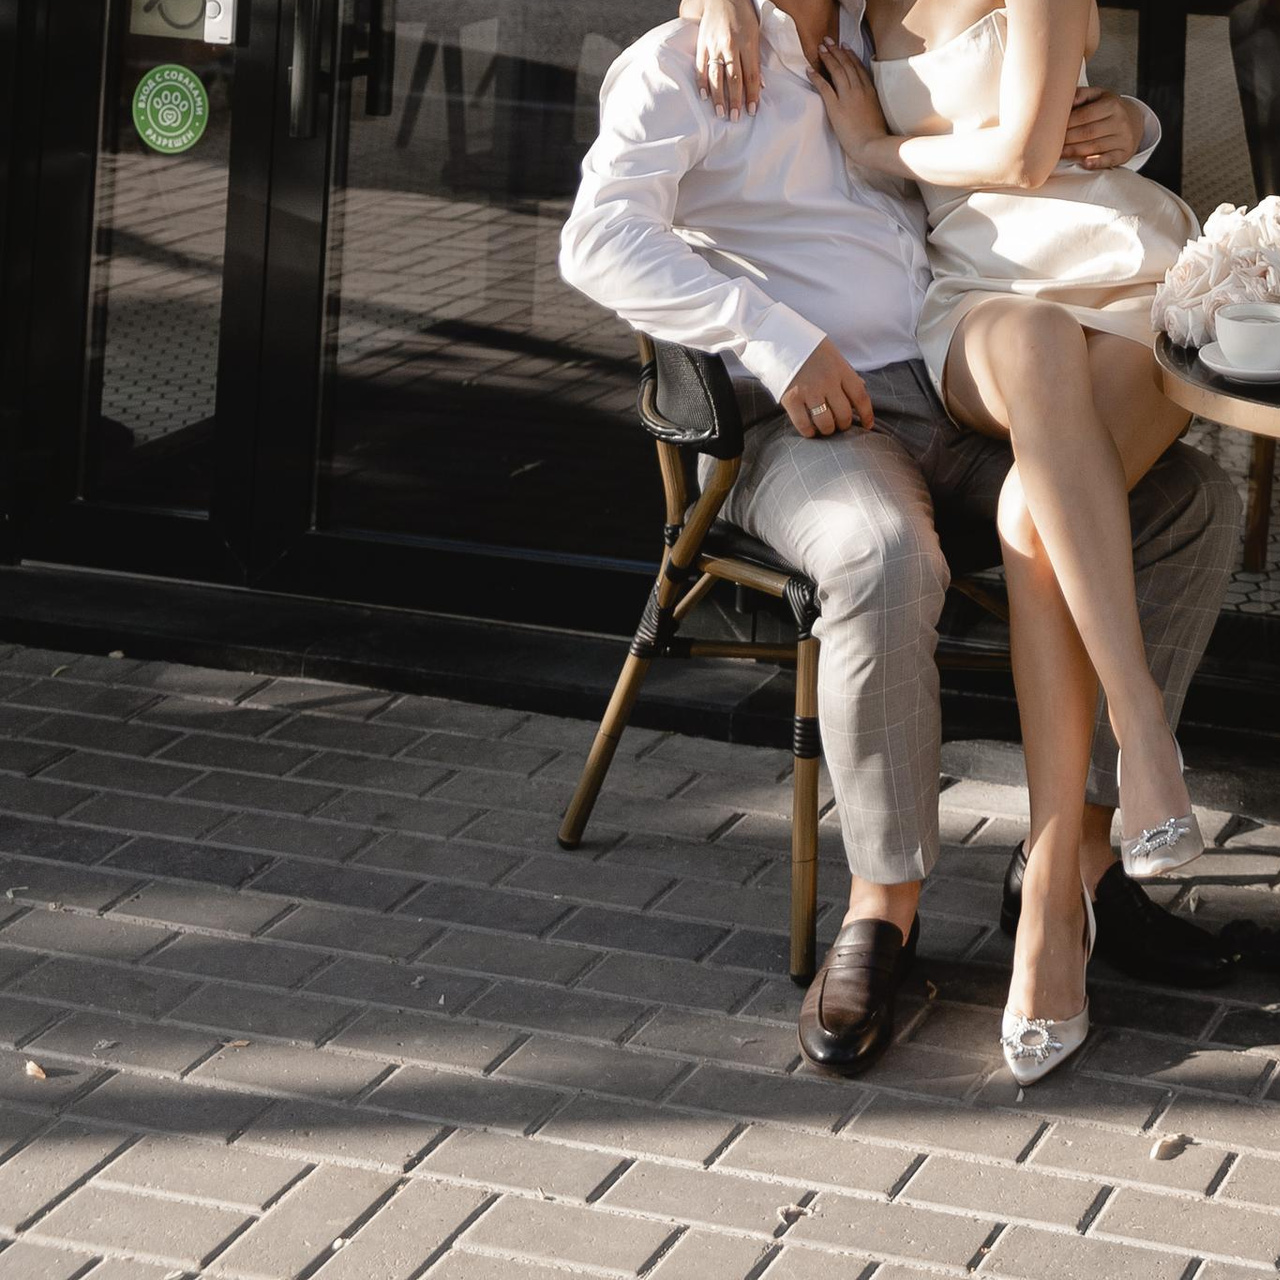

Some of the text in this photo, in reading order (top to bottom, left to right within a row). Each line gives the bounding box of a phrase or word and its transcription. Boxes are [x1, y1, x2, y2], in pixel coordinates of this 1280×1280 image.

[137, 70, 204, 116] ВХОД С СОБАКАМИ
[145, 127, 195, 149] РАЗРЕШЕН
